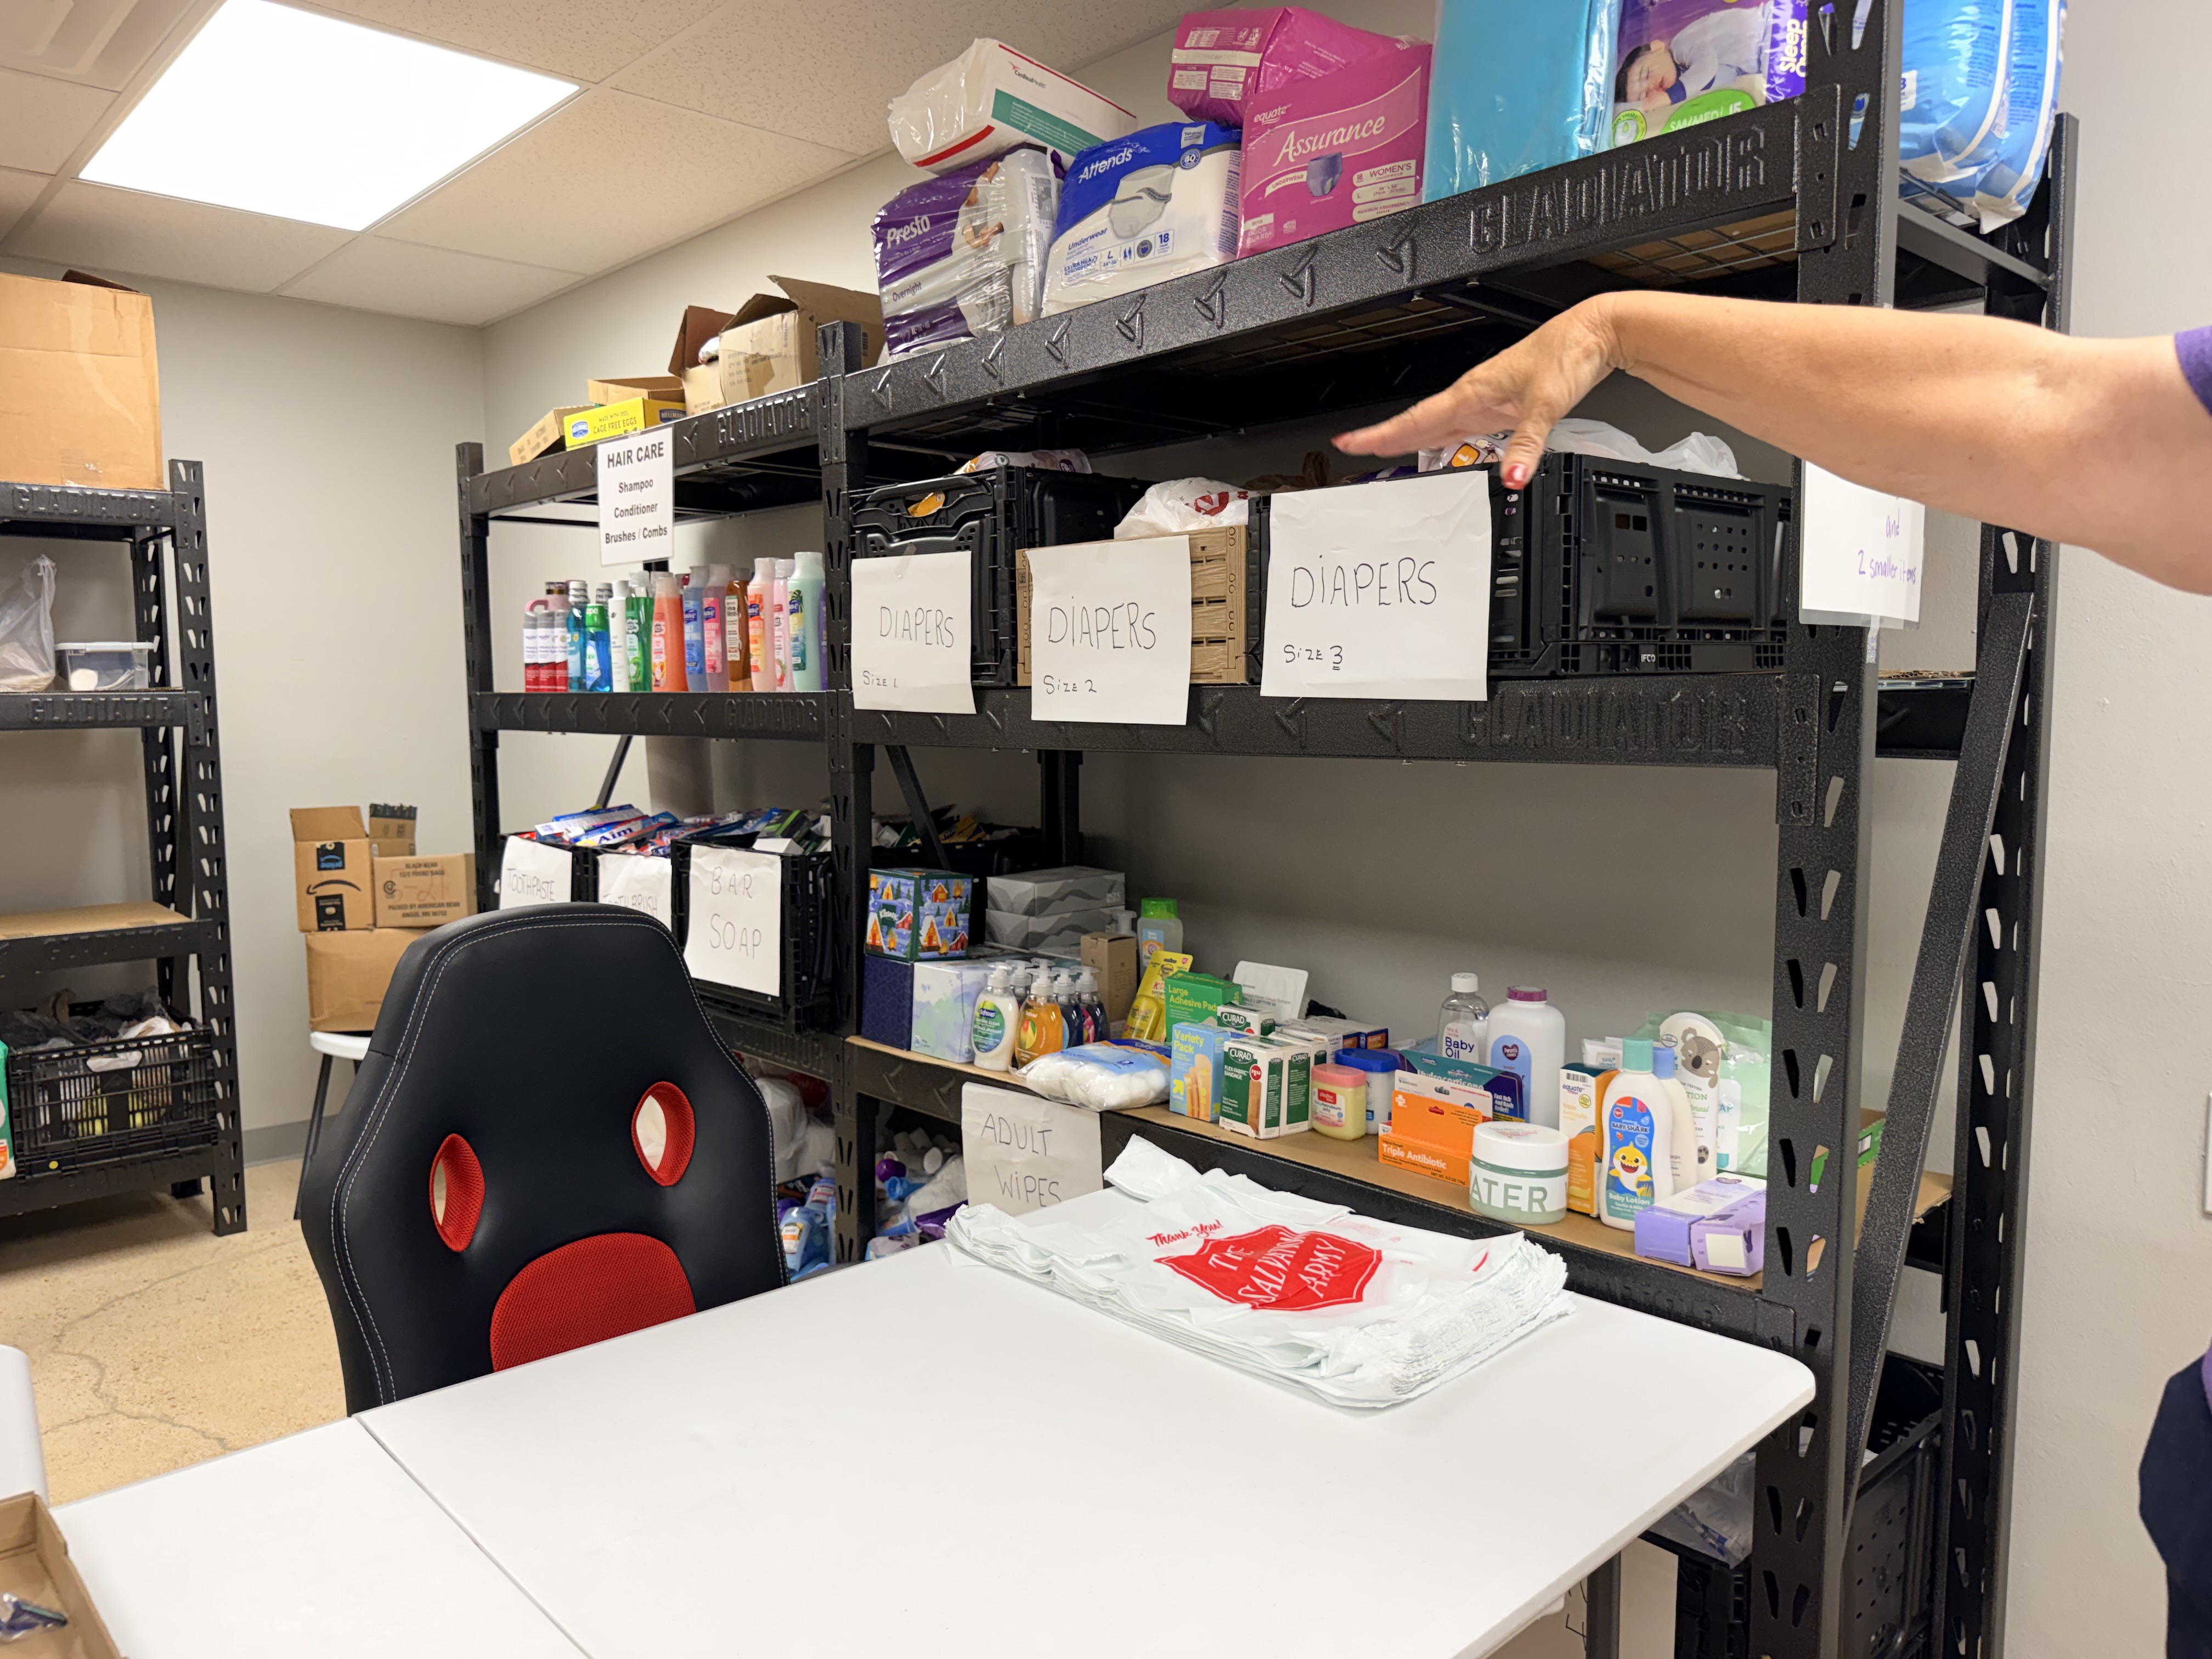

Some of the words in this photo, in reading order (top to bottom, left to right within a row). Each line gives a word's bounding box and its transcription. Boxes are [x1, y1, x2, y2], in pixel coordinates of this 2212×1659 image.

[1779, 19, 1802, 73] Sleep
[1254, 106, 1286, 123] equate
[1273, 116, 1385, 167] Assurance
[1078, 148, 1133, 184] Attends
[1369, 163, 1412, 178] WOMEN'S
[1272, 174, 1304, 189] UNDERWEAR
[1471, 127, 1764, 253] GLADIATOR
[886, 215, 931, 250] Presto
[1068, 228, 1108, 251] Underwear
[1159, 233, 1170, 244] 18
[1107, 251, 1113, 259] L
[893, 281, 922, 302] Overnight
[593, 424, 607, 435] CAGE
[608, 421, 622, 431] FREE
[622, 416, 637, 428] EGGS
[607, 450, 634, 469] HAIR
[636, 441, 664, 463] CARE
[618, 476, 654, 495] Shampoo
[13, 486, 161, 520] GLADIATOR
[614, 501, 658, 520] Conditioner
[1886, 508, 1900, 539] and
[605, 530, 635, 545] Brushes
[642, 524, 668, 539] Combs
[1858, 549, 1866, 575] 2
[1870, 554, 1898, 579] smaller
[879, 606, 955, 648] DIAPERS
[1331, 645, 1344, 664] 3
[1641, 653, 1656, 663] IFCO
[1085, 680, 1097, 693] 2
[598, 827, 634, 845] Aim
[506, 868, 555, 902] TOOTHPASTE
[711, 866, 752, 899] BAR
[709, 913, 761, 959] SOAP
[1168, 984, 1189, 996] Large
[1169, 995, 1202, 1009] Adhesive
[1221, 1012, 1245, 1024] CURAD
[1174, 1029, 1204, 1047] Variety
[1174, 1040, 1194, 1054] Pack
[1445, 1036, 1475, 1053] Baby
[1229, 1048, 1252, 1060] CURAD
[1291, 1053, 1308, 1062] CURAD
[1445, 1047, 1460, 1060] Oil
[1224, 1070, 1243, 1080] BANDAGE
[1562, 1084, 1583, 1093] equate
[980, 1113, 1052, 1157] ADULT
[1611, 1122, 1626, 1131] BABY
[1627, 1124, 1648, 1133] SHARK
[1382, 1143, 1405, 1158] Triple
[1407, 1150, 1447, 1170] Antibiotic
[1470, 1169, 1548, 1212] ATER
[1609, 1192, 1624, 1203] Baby
[1626, 1195, 1650, 1205] Lotion
[1146, 1228, 1192, 1246] Thank
[1192, 1219, 1224, 1239] You!
[1208, 1244, 1253, 1271] THE
[1238, 1231, 1310, 1304] SALVATION
[1297, 1238, 1347, 1299] ARMY
